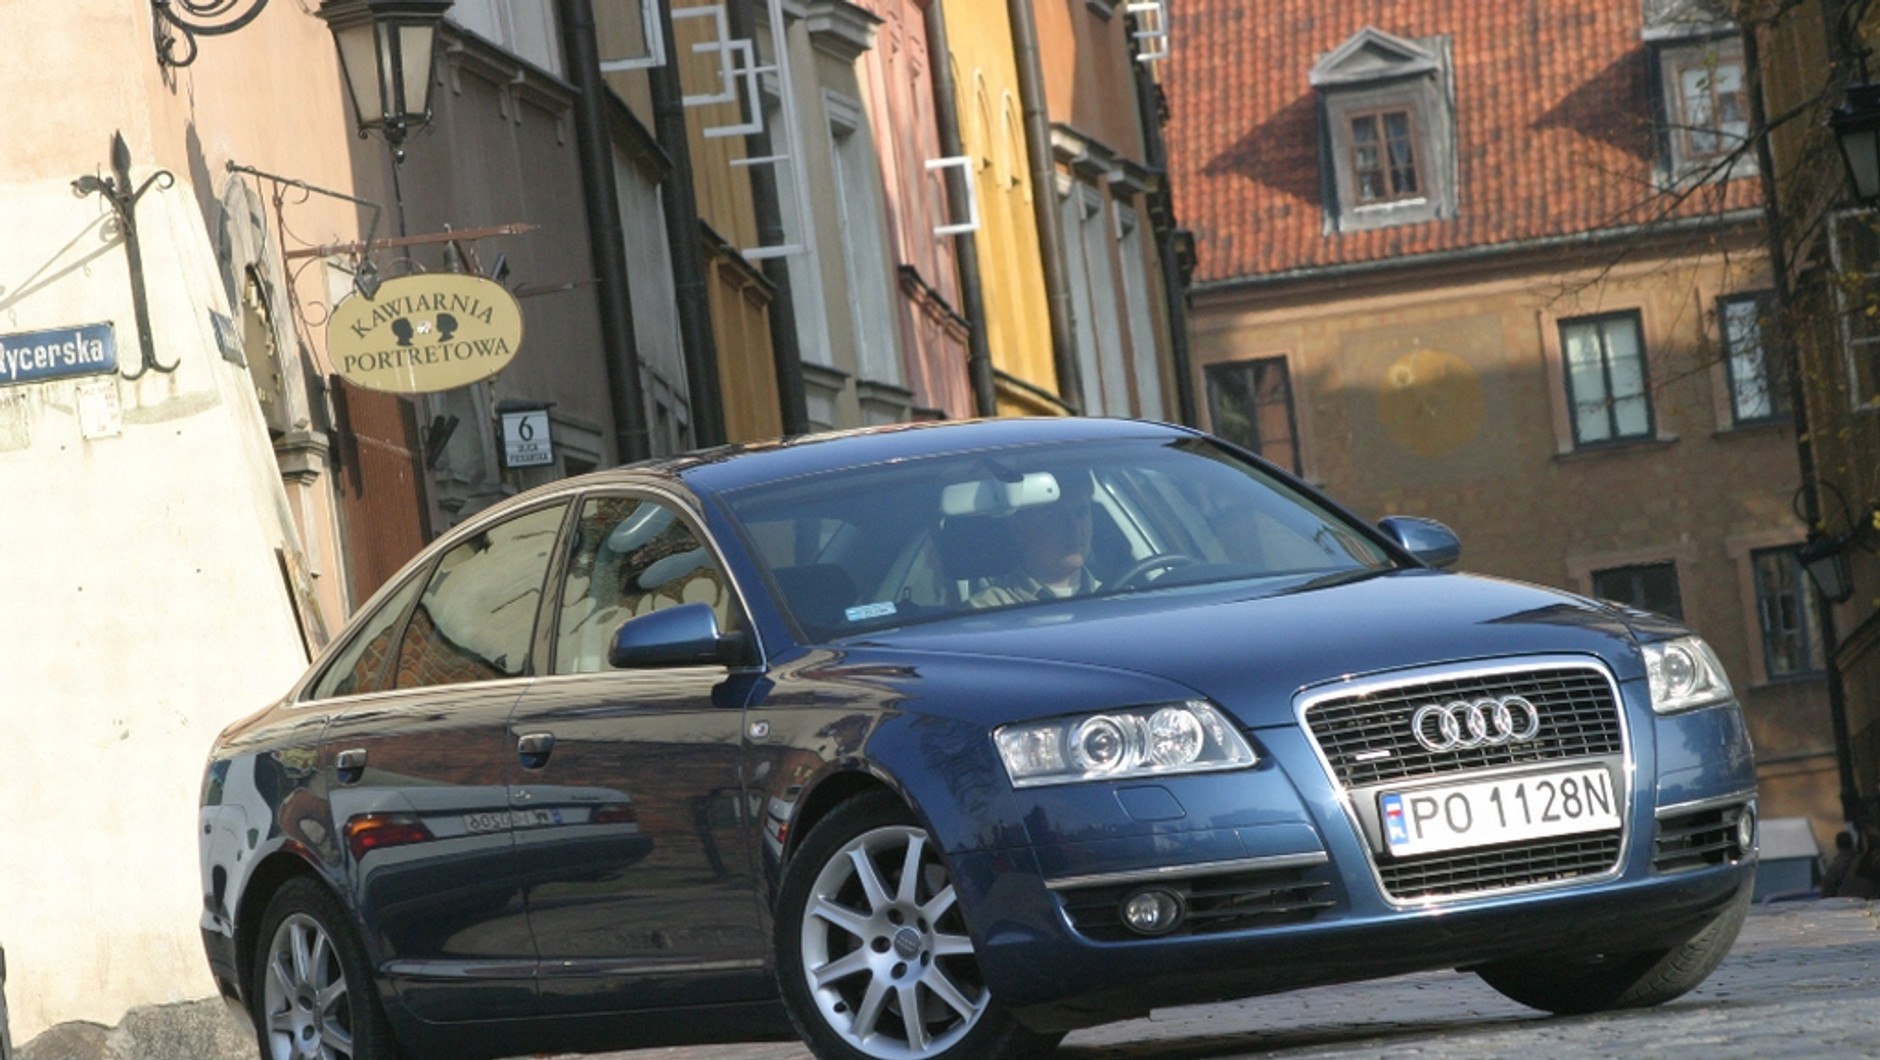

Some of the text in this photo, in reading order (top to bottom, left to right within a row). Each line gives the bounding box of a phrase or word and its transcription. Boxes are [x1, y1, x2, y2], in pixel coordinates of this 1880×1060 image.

[351, 293, 494, 339] KAWIARNIA
[344, 337, 511, 373] PORTRETOWA
[518, 416, 533, 441] 6
[1410, 773, 1610, 839] PO 1128N
